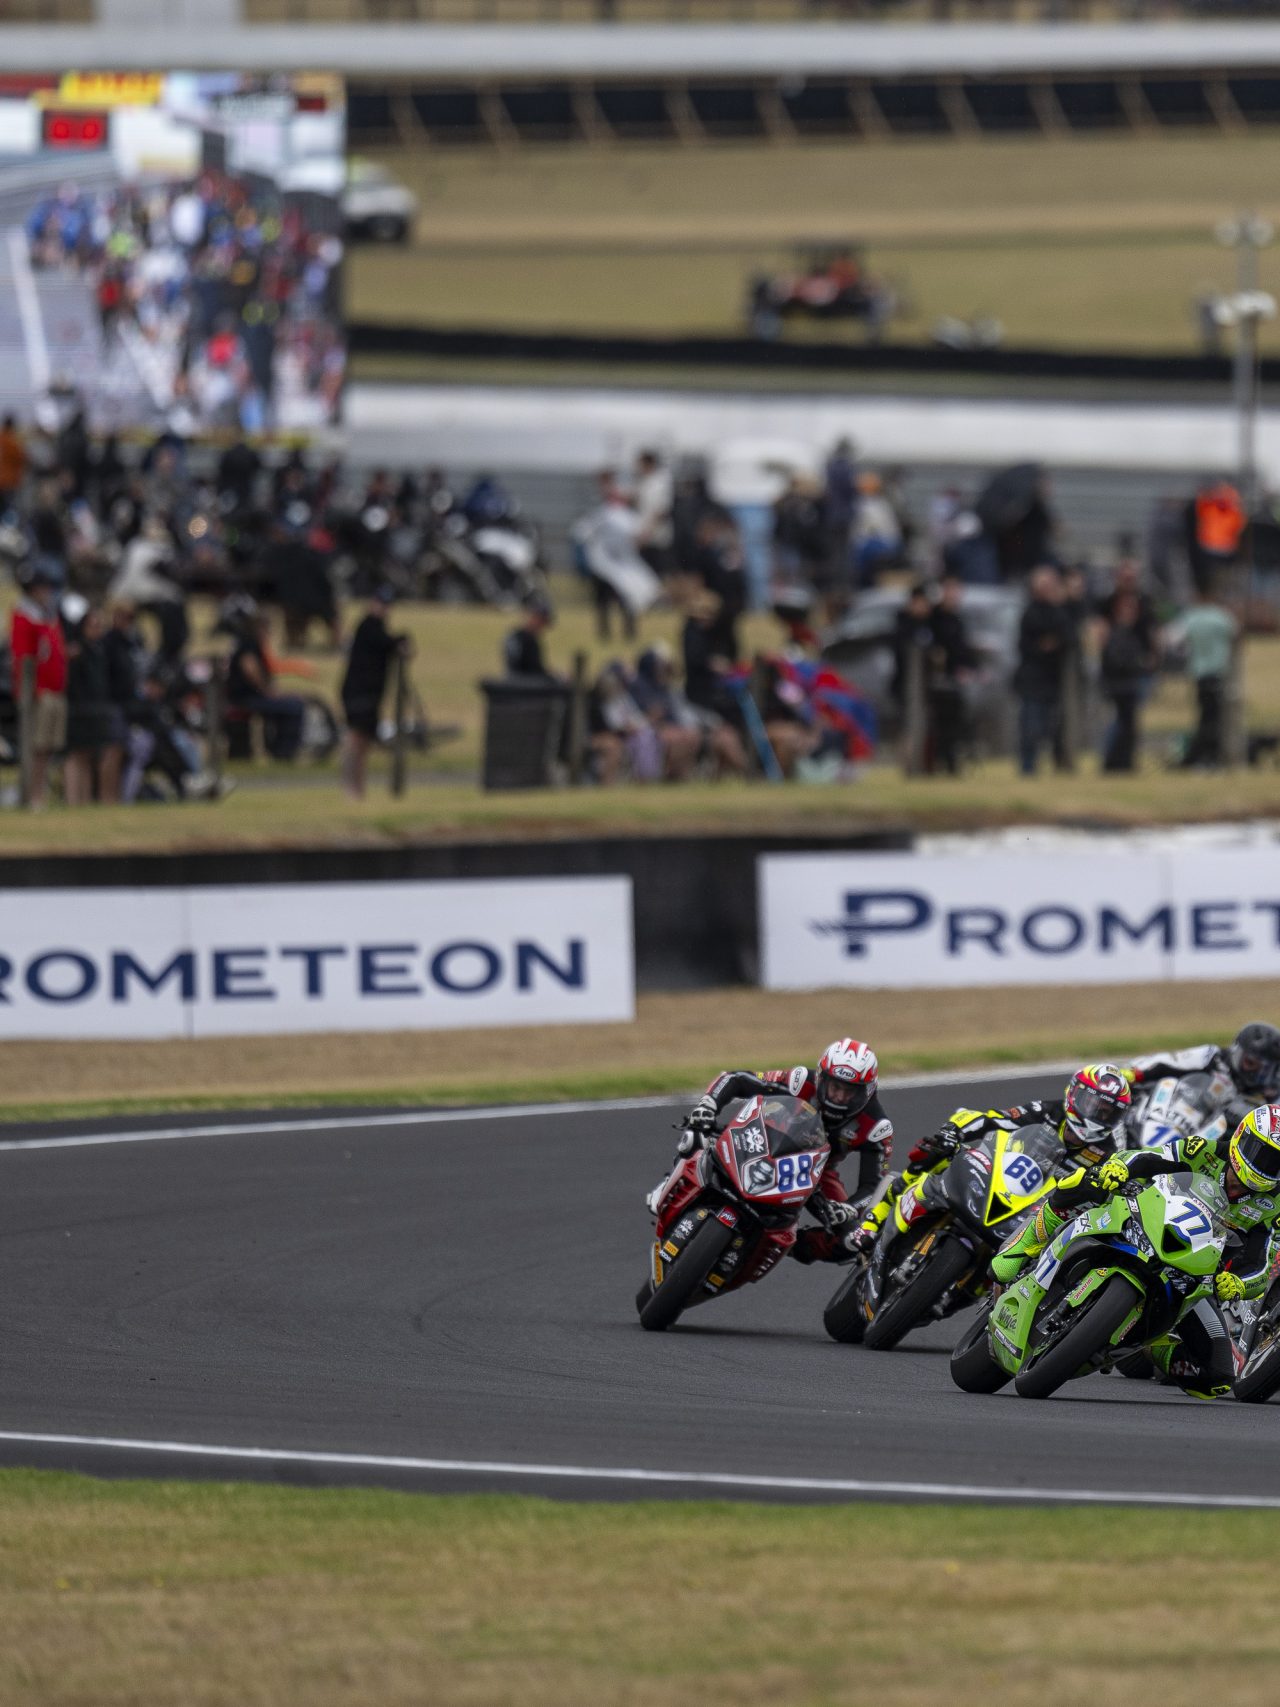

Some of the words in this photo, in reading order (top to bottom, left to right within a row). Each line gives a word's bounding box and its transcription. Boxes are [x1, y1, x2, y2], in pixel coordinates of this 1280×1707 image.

[837, 1067, 857, 1078] Arai
[778, 1154, 812, 1193] 88
[1004, 1155, 1042, 1194] 69
[1169, 1200, 1212, 1237] 77
